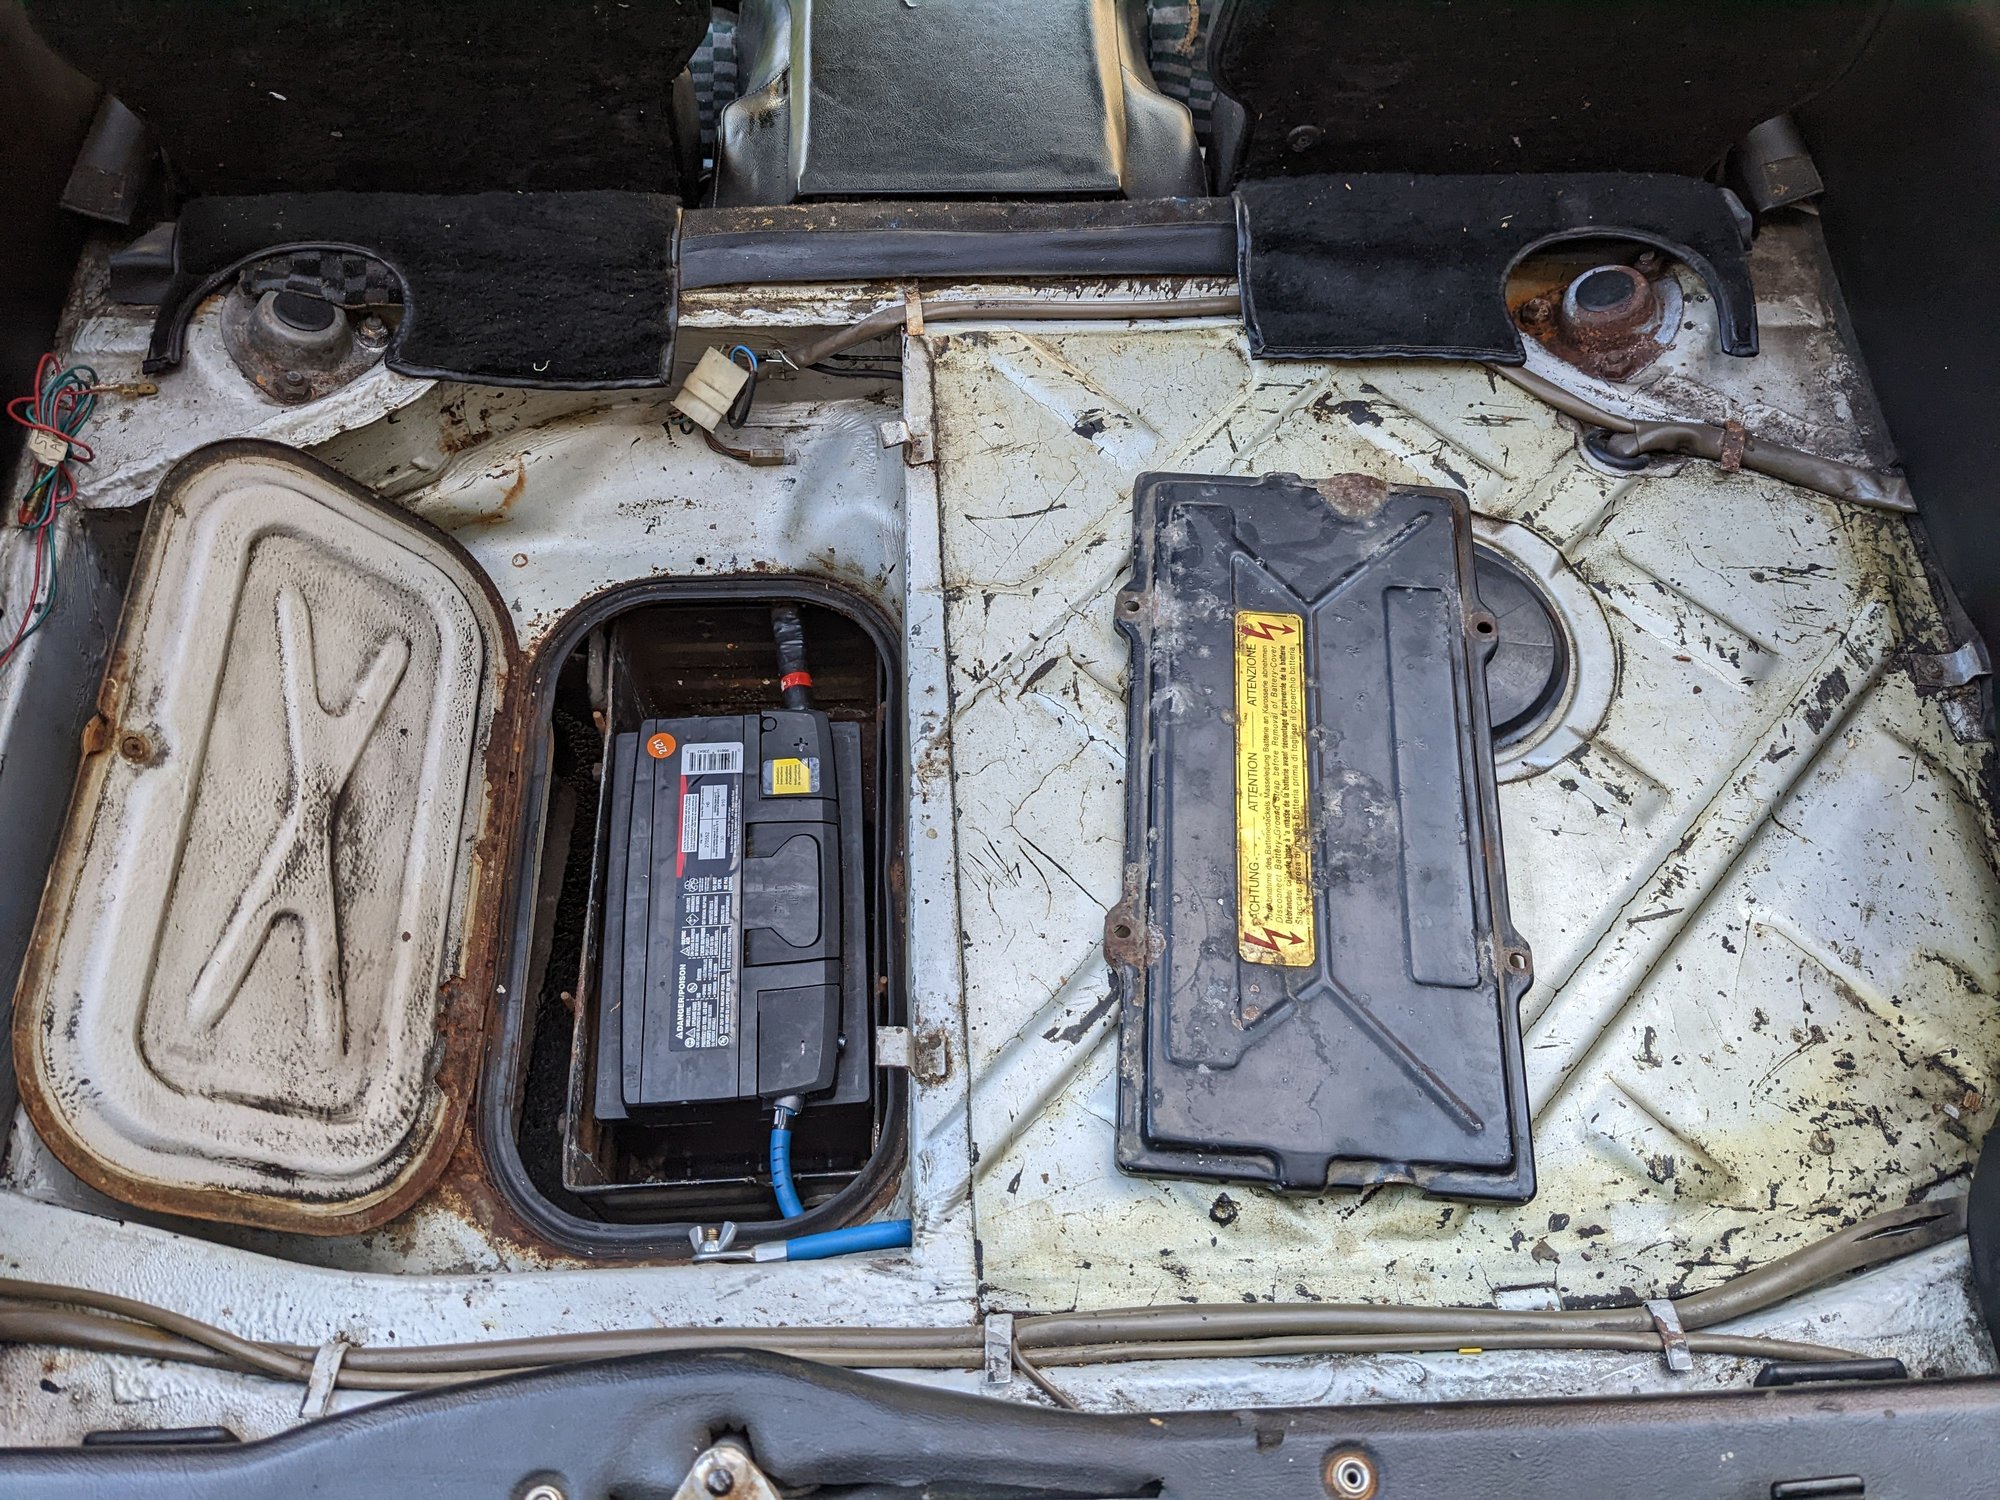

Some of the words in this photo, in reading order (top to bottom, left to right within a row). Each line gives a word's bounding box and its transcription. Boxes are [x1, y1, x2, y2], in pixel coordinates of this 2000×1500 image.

[1246, 644, 1256, 706] ATTENZIONE
[1263, 716, 1268, 724] an
[1271, 701, 1277, 709] of
[1271, 712, 1279, 746] Removal
[1248, 753, 1258, 812] ATTENTION
[676, 964, 686, 1032] DANGER/POISON
